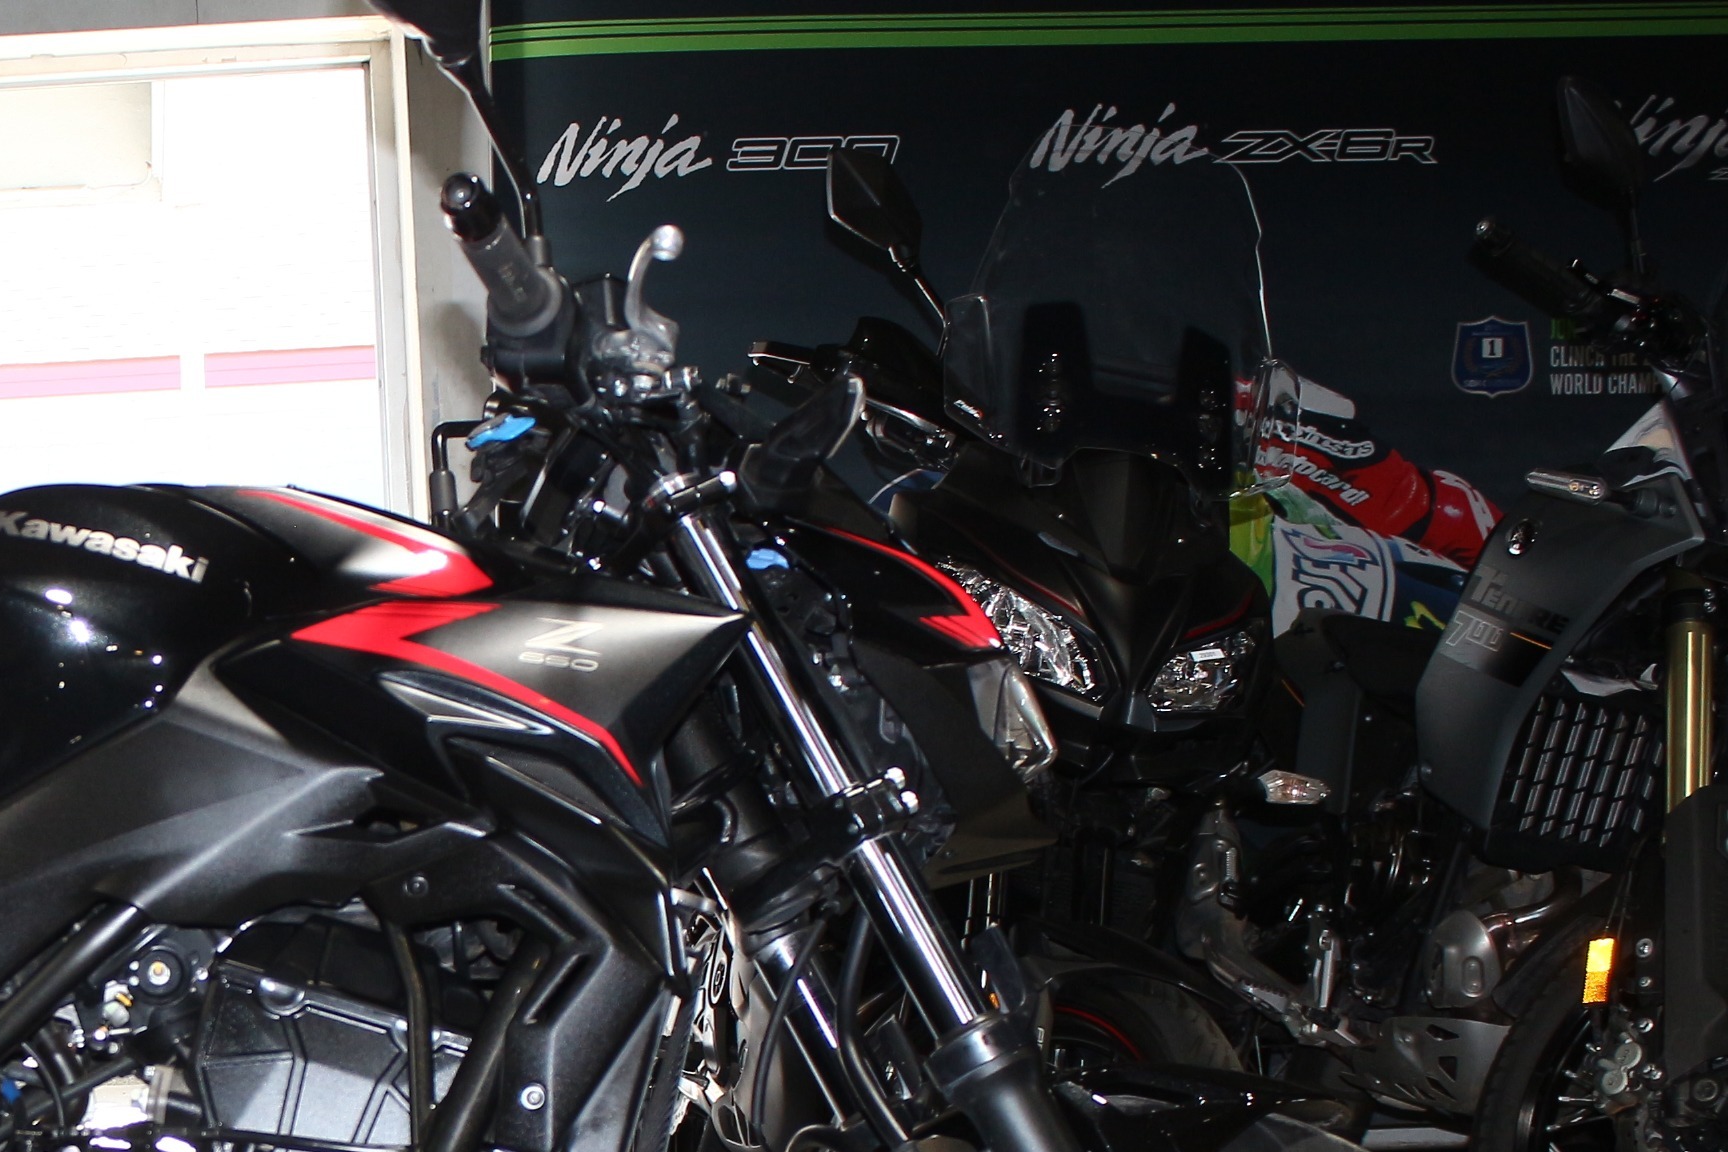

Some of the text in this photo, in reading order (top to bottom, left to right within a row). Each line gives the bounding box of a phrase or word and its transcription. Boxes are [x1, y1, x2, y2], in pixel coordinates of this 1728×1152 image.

[536, 112, 712, 203] Ninja
[1029, 102, 1208, 189] Ninja
[1550, 373, 1604, 395] WORLD
[524, 617, 605, 656] Z
[518, 651, 599, 672] 650
